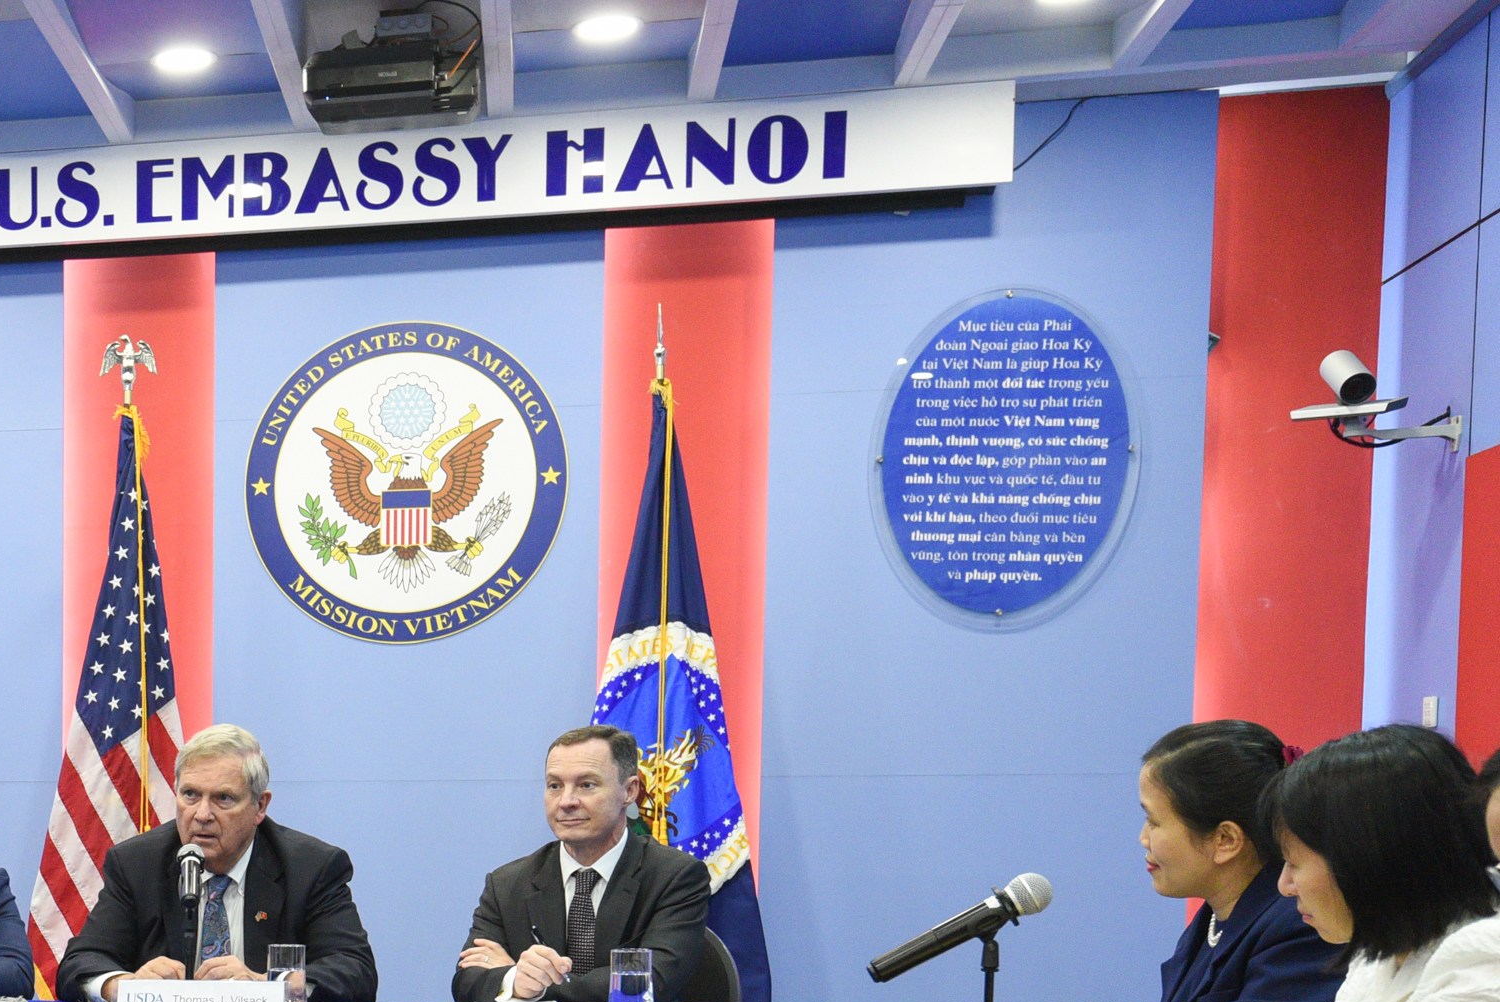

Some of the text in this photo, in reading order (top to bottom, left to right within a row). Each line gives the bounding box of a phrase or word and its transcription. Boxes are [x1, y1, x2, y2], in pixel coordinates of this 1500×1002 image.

[136, 133, 514, 223] EMBASSY
[546, 110, 849, 197] HANOI
[262, 330, 550, 446] UNITED STATES OF AMERICA
[431, 428, 462, 452] UNUM
[288, 566, 524, 637] MISSION VIETNAM
